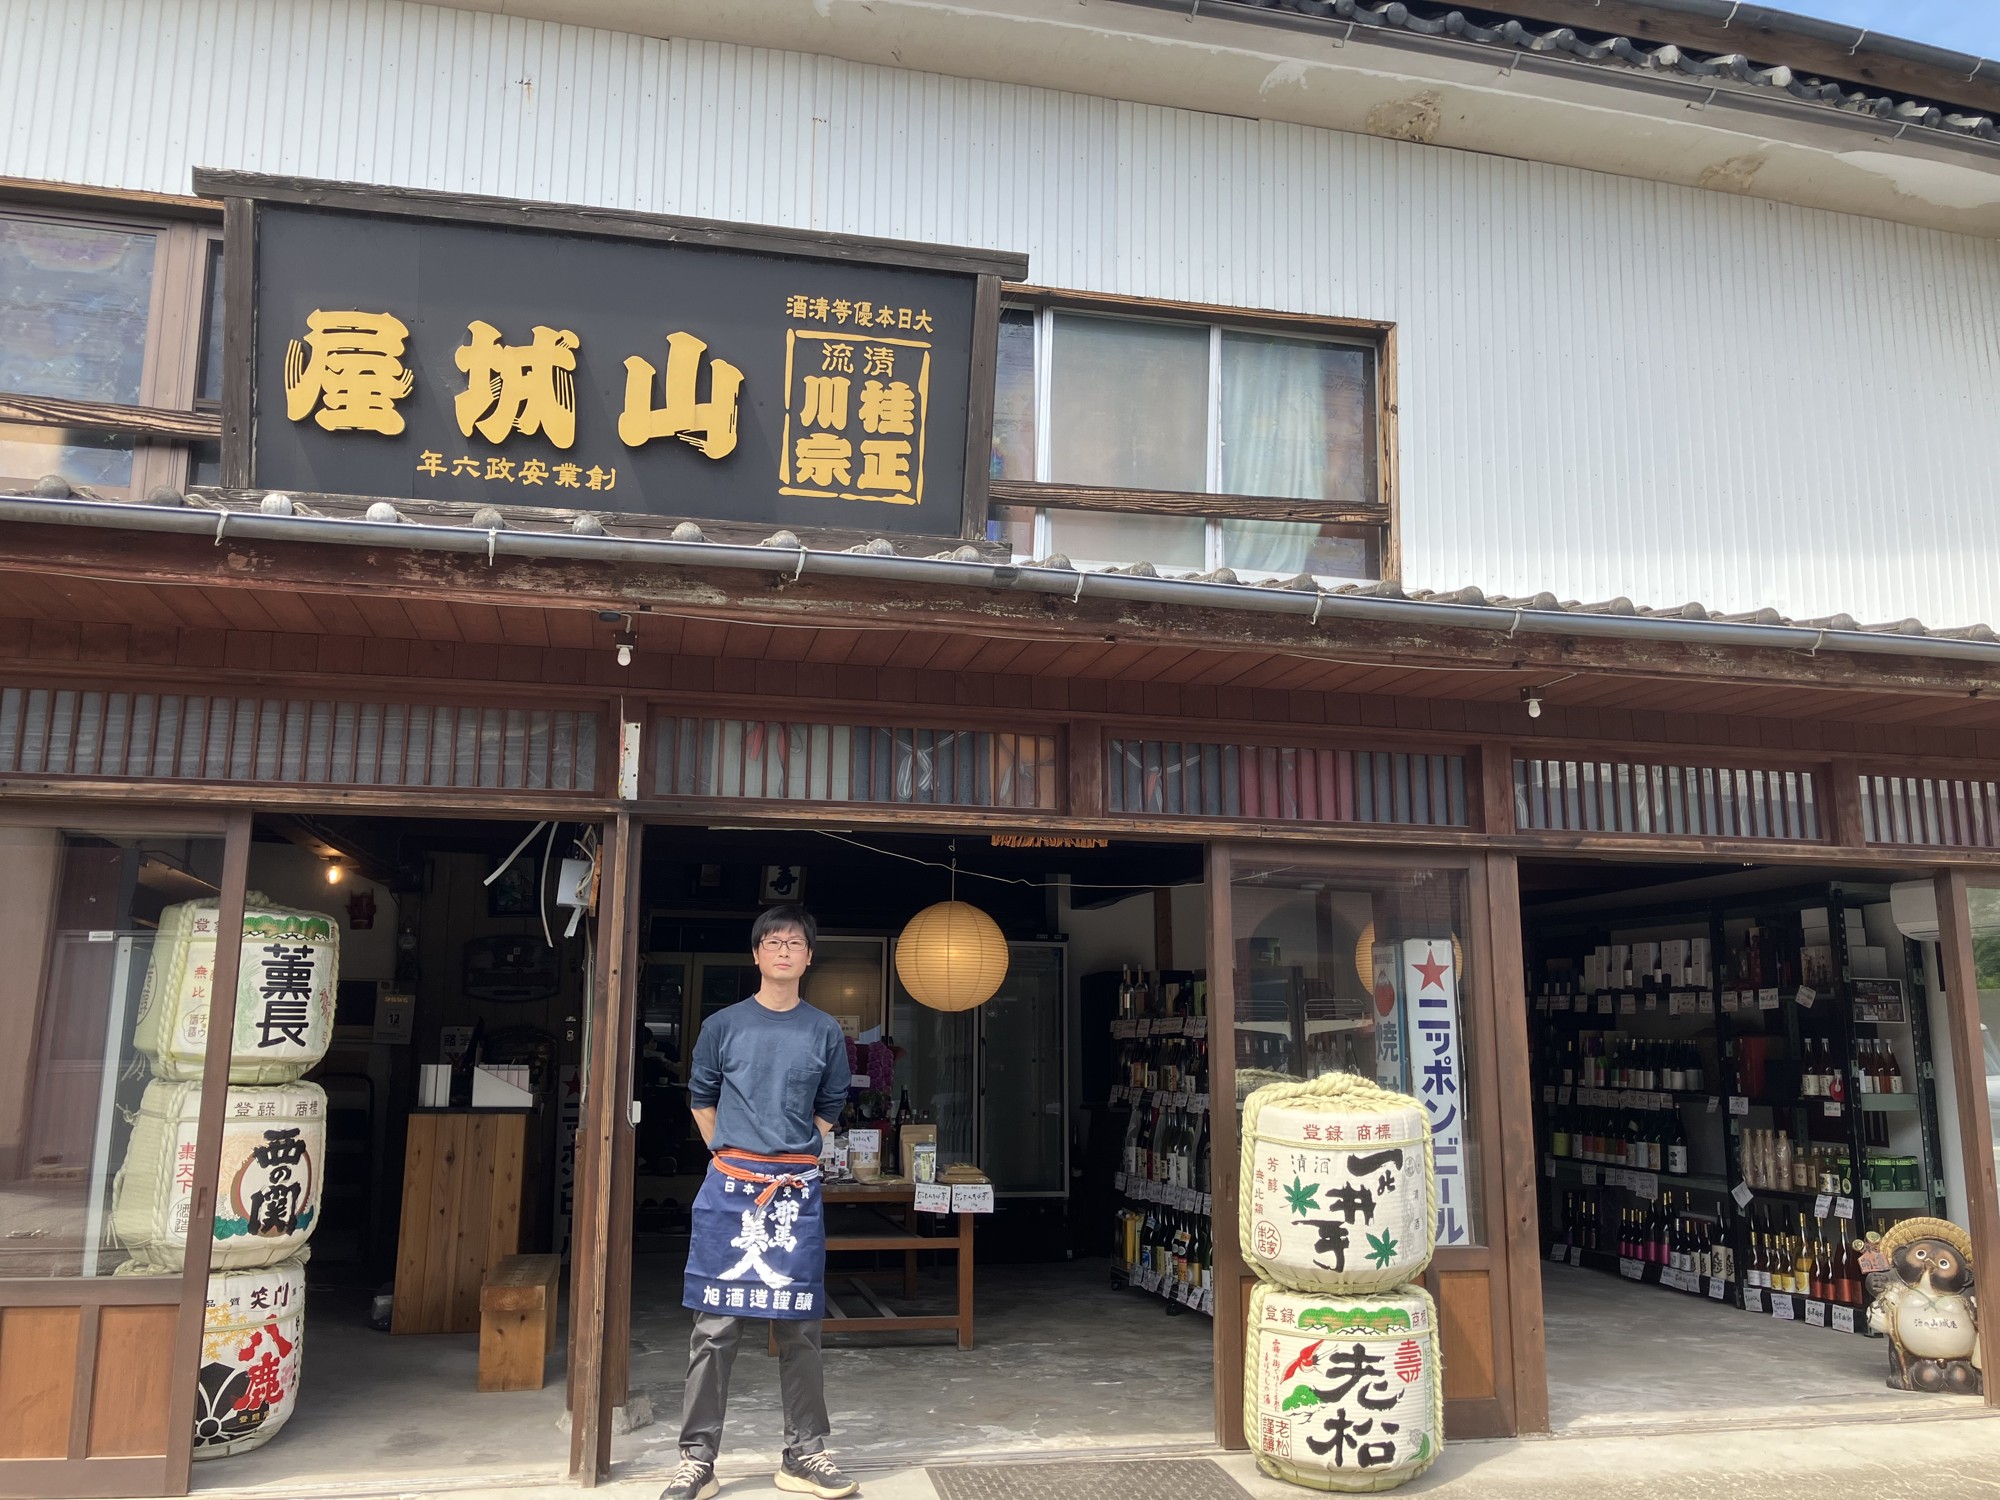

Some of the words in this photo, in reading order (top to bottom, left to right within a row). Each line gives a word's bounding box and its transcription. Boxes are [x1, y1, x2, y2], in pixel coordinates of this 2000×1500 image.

[284, 308, 745, 460] 山城屋
[416, 450, 617, 491] 創業安政六年
[1291, 1154, 1331, 1175] 清酒
[1418, 999, 1464, 1245] ニッポンビール
[248, 1128, 306, 1236] 西の関
[233, 1313, 293, 1411] 八鹿
[1305, 1342, 1405, 1468] 老松
